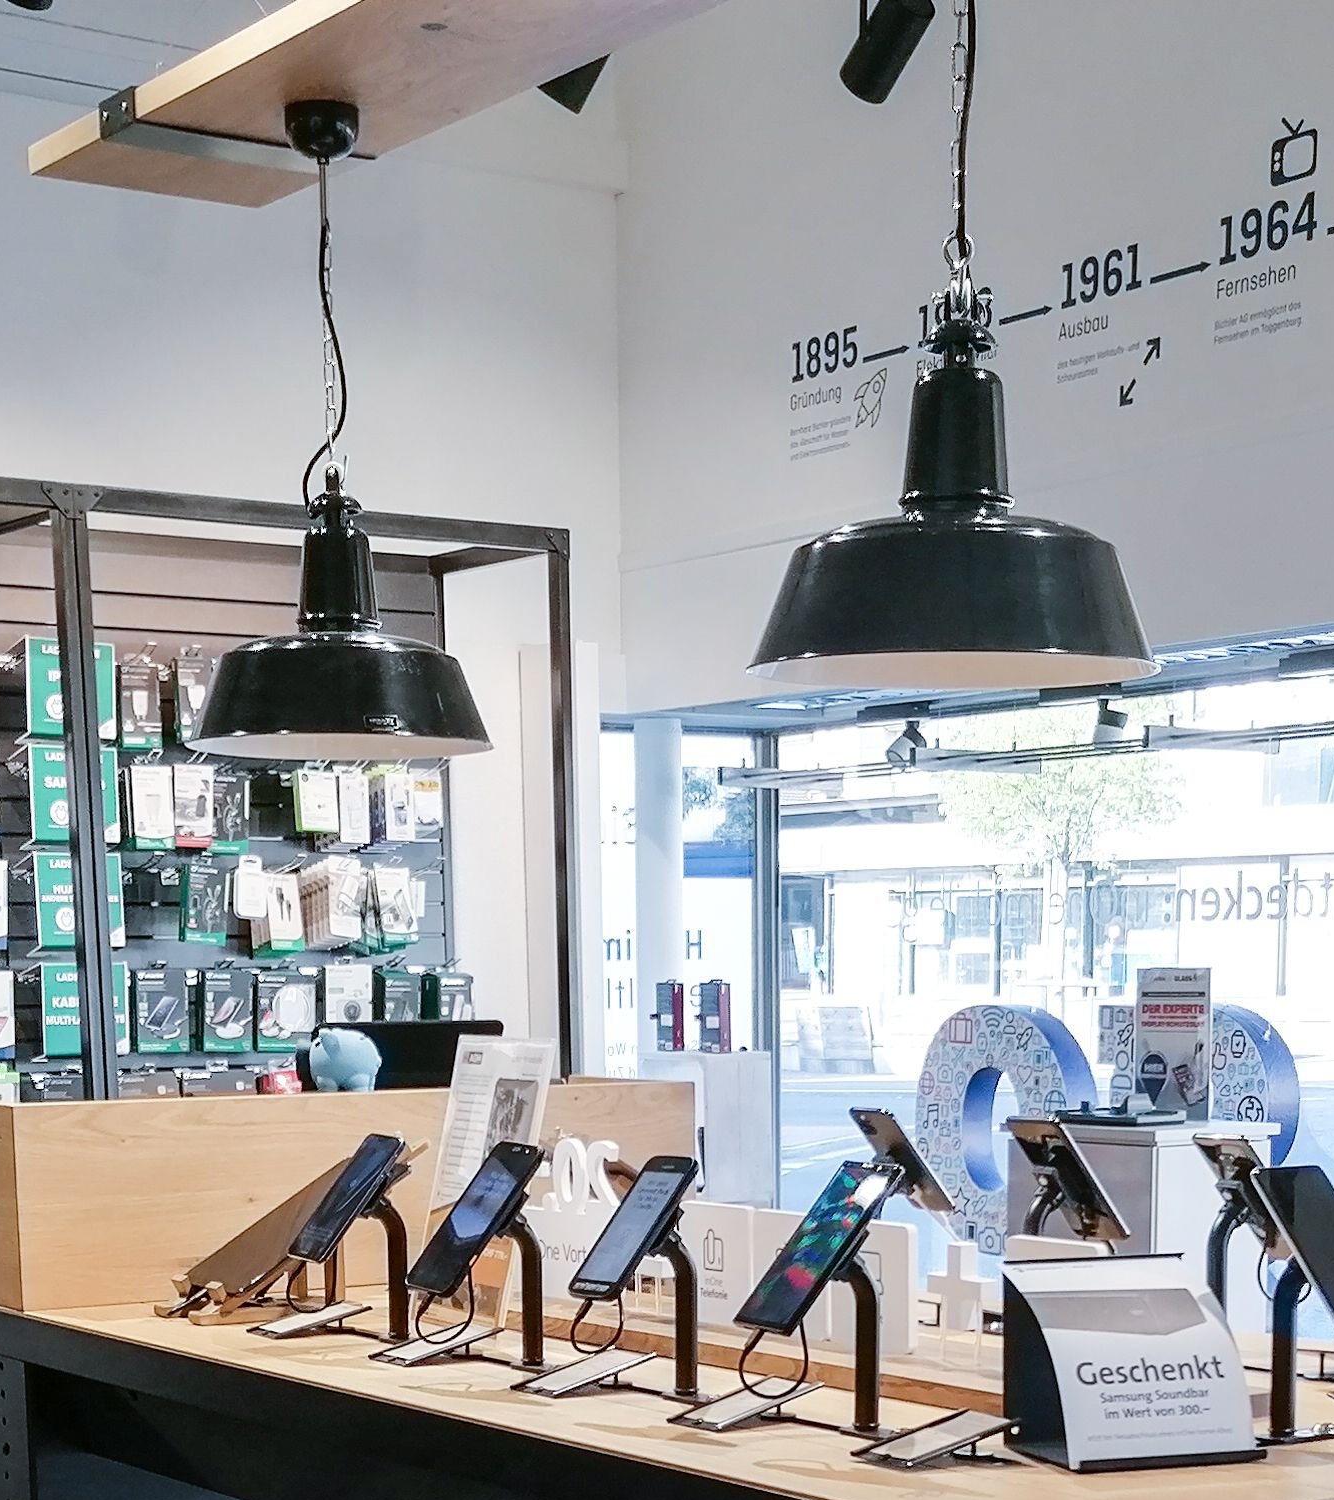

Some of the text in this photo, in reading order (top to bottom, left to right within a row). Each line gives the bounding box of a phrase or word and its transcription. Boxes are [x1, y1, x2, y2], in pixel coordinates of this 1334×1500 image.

[1219, 190, 1317, 266] 1964
[1061, 243, 1142, 309] 1961
[1216, 264, 1297, 299] Fernsehen
[1058, 313, 1109, 341] Ausbau
[792, 325, 858, 384] 1895
[789, 384, 842, 412] Gründung
[1141, 1003, 1161, 1014] DER
[1076, 1354, 1225, 1386] Geschenkt
[1099, 1387, 1209, 1404] Samsung Soundbar
[1104, 1408, 1120, 1420] im
[1123, 1405, 1151, 1418] Wert
[1154, 1407, 1176, 1417] von
